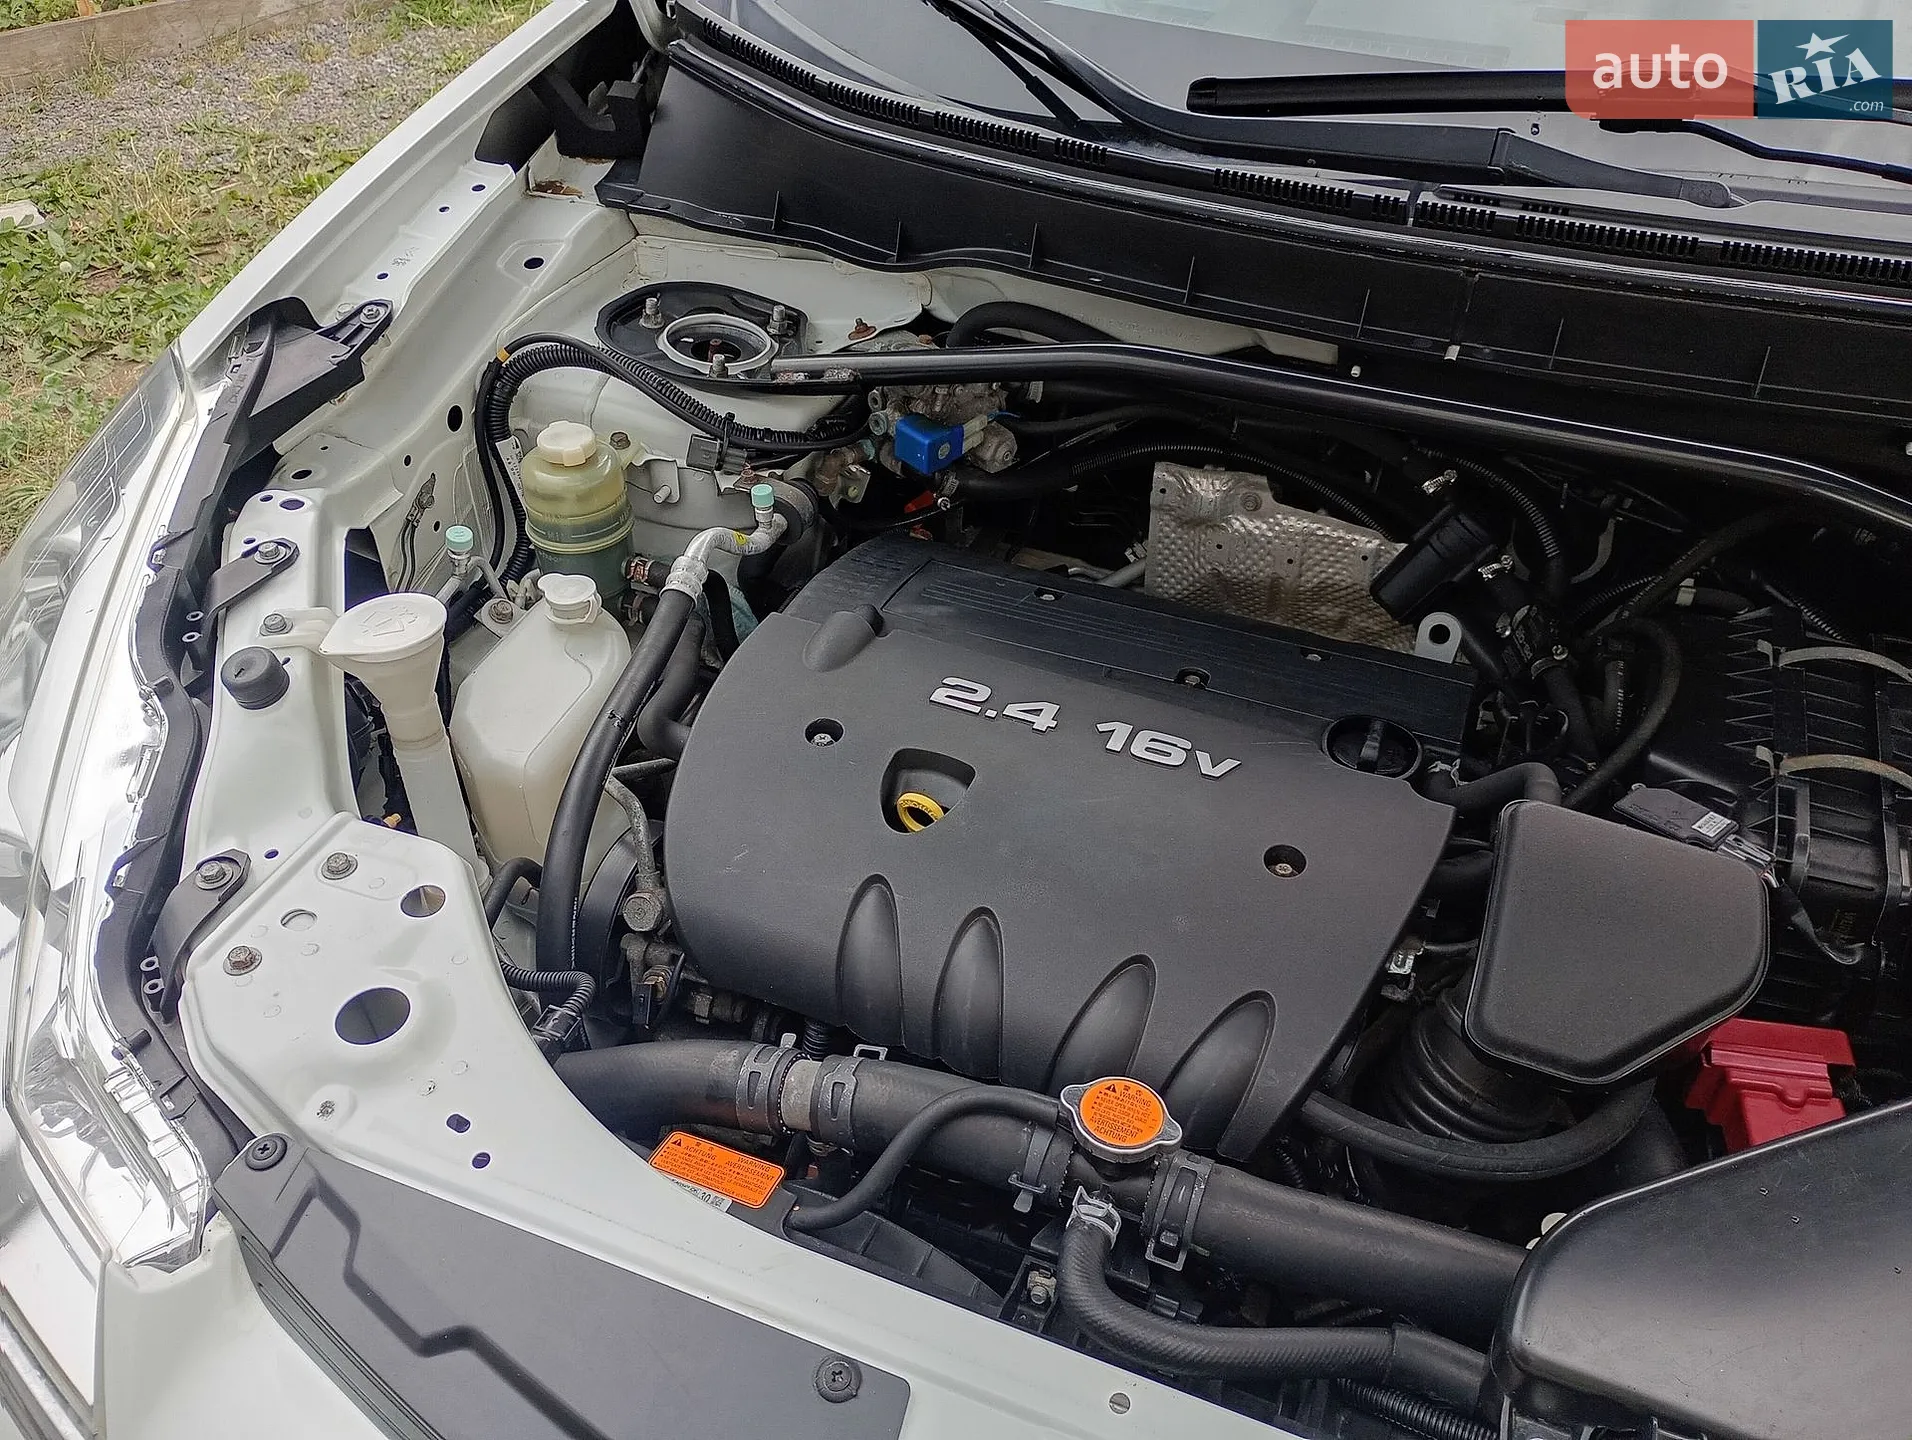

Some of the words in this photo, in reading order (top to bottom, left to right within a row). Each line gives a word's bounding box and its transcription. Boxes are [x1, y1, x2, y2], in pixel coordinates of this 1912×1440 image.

[929, 676, 1061, 734] 2.4
[1119, 1089, 1152, 1108] WARNING
[1093, 1125, 1128, 1143] ACHTUNG
[683, 1144, 717, 1161] ACHTUNG
[725, 1160, 775, 1181] AVERTISSEMENT
[737, 1156, 771, 1172] WARNING
